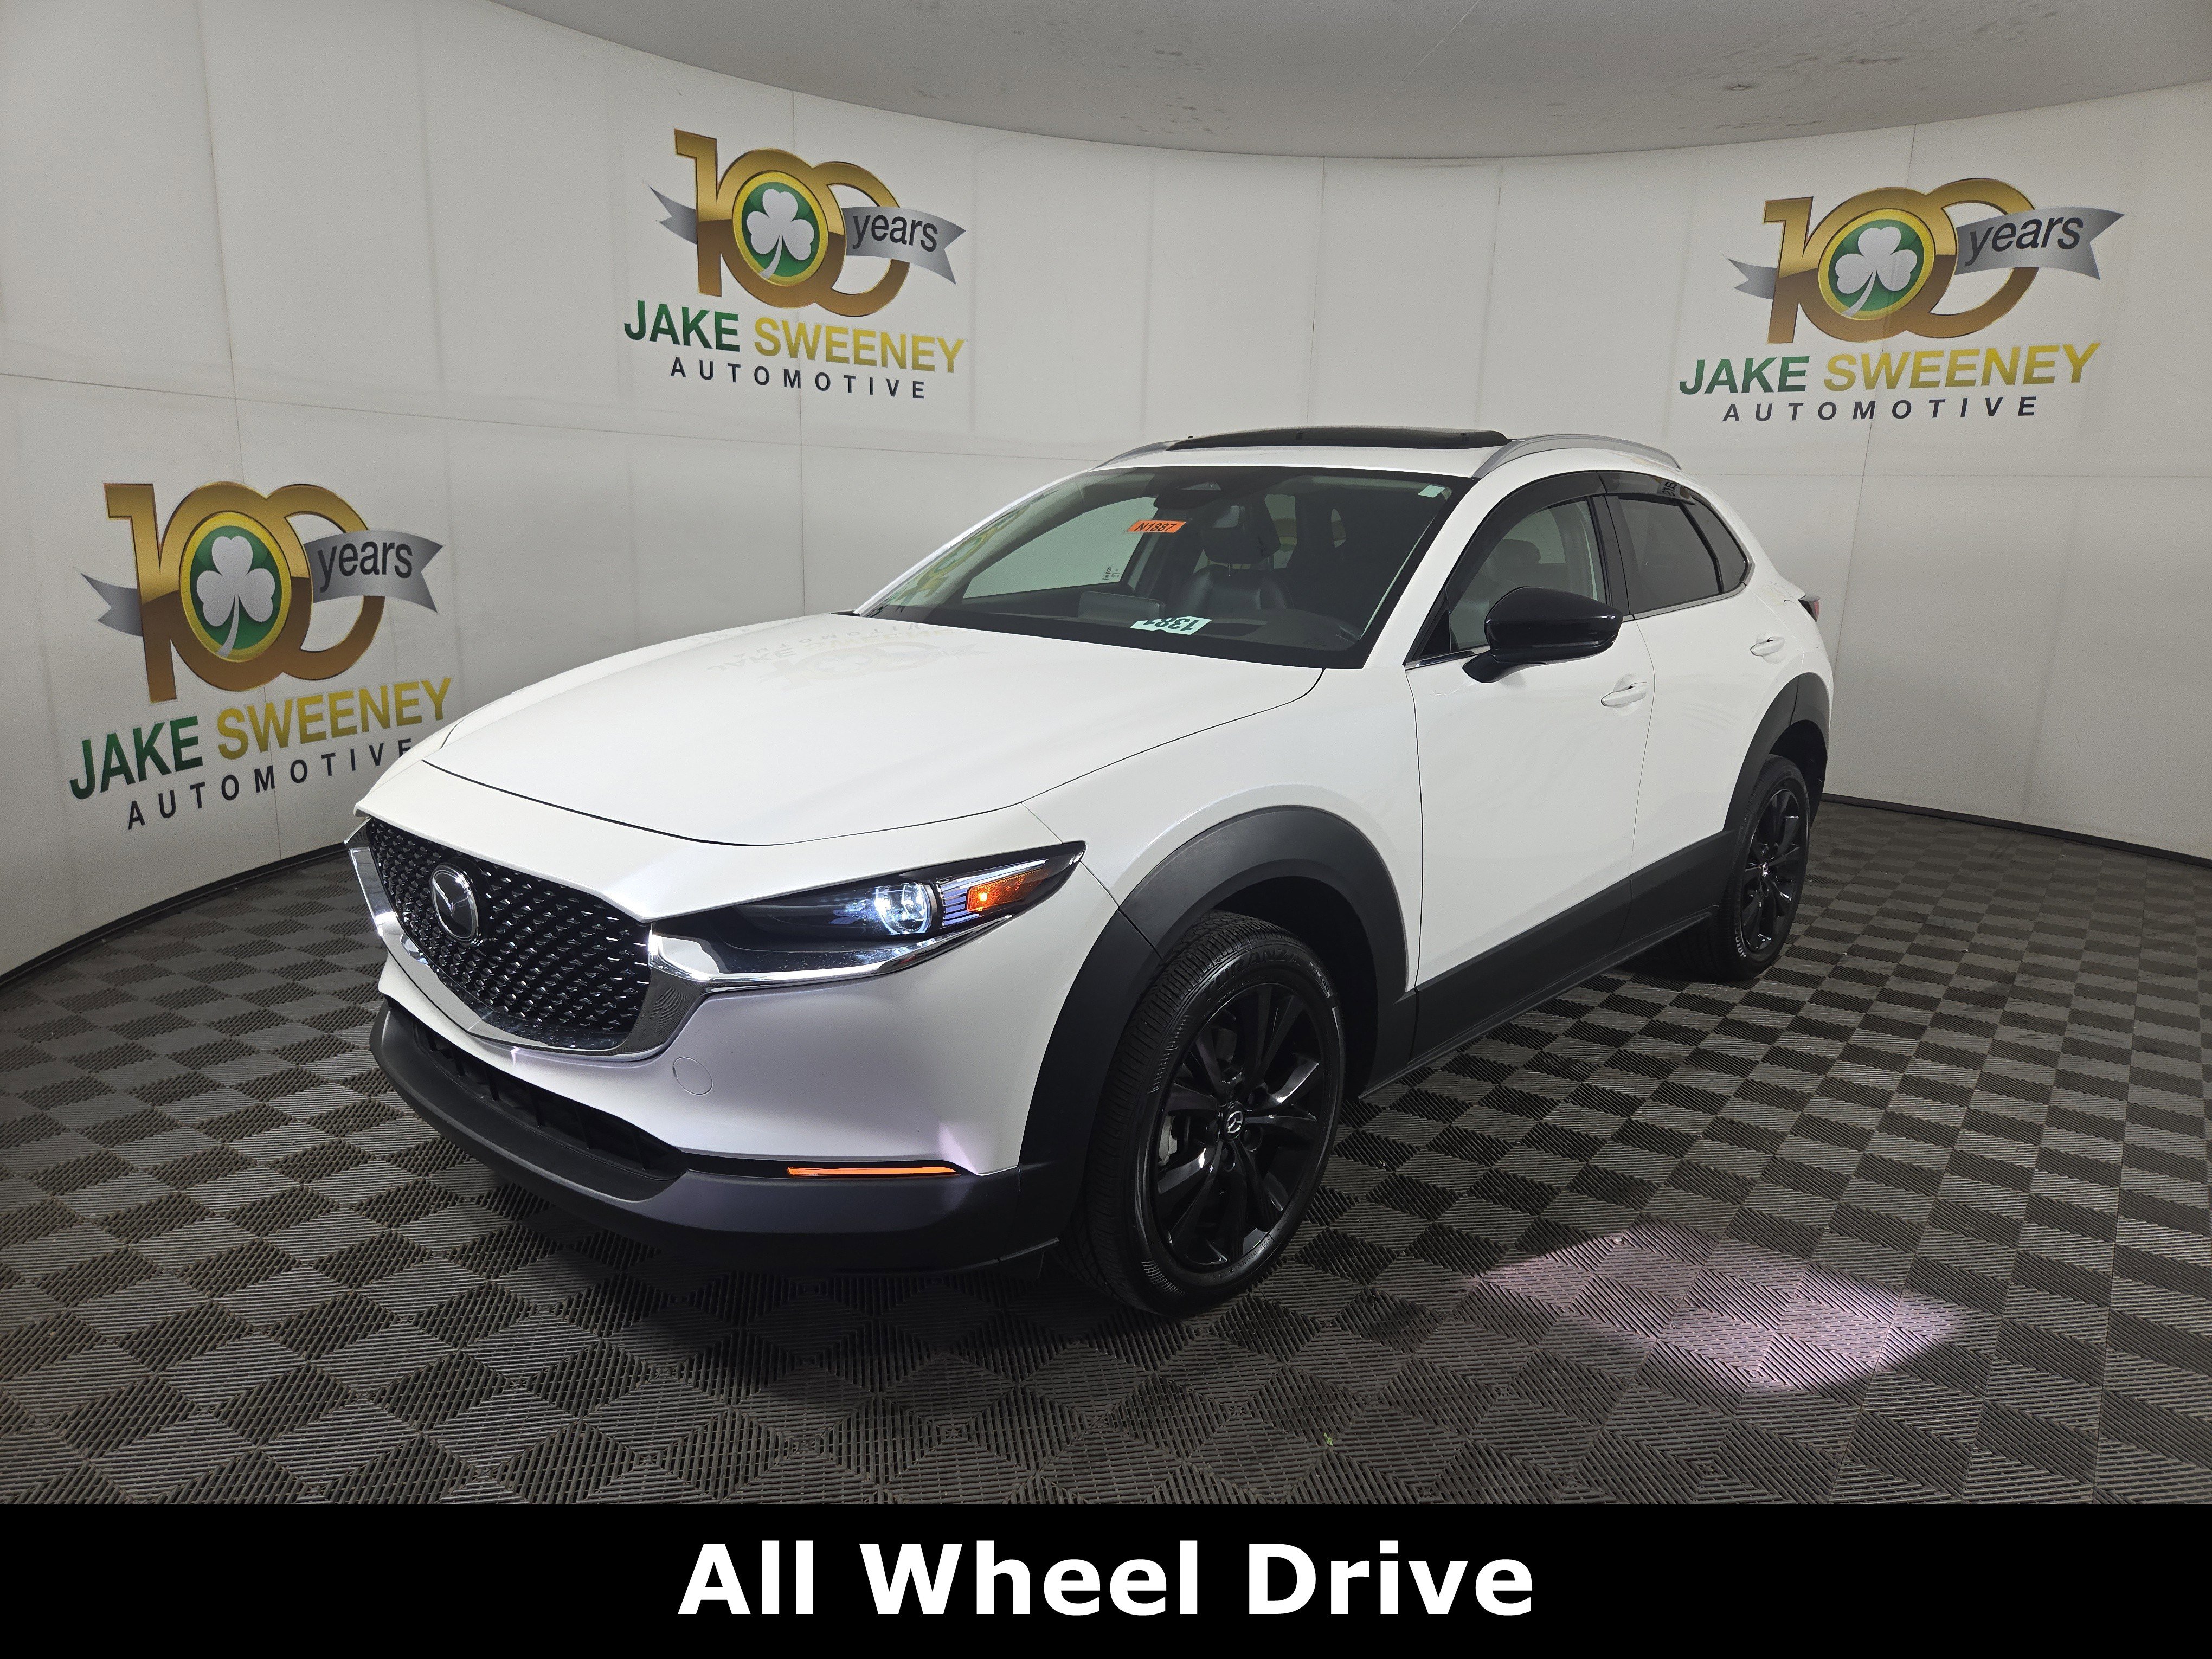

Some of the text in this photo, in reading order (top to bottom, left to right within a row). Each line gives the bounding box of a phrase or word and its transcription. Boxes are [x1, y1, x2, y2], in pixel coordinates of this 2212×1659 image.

[852, 213, 938, 252] years
[1963, 216, 2084, 267] years
[623, 300, 966, 374] JAKE SWEENEY
[670, 357, 925, 400] AUTOMOTIVE
[1679, 342, 2101, 395] JAKE SWEENEY
[1722, 396, 2037, 422] AUTOMOTIVE
[1134, 522, 1177, 532] N1887
[318, 541, 414, 593] years
[69, 678, 453, 800] JAKE SWEENEY
